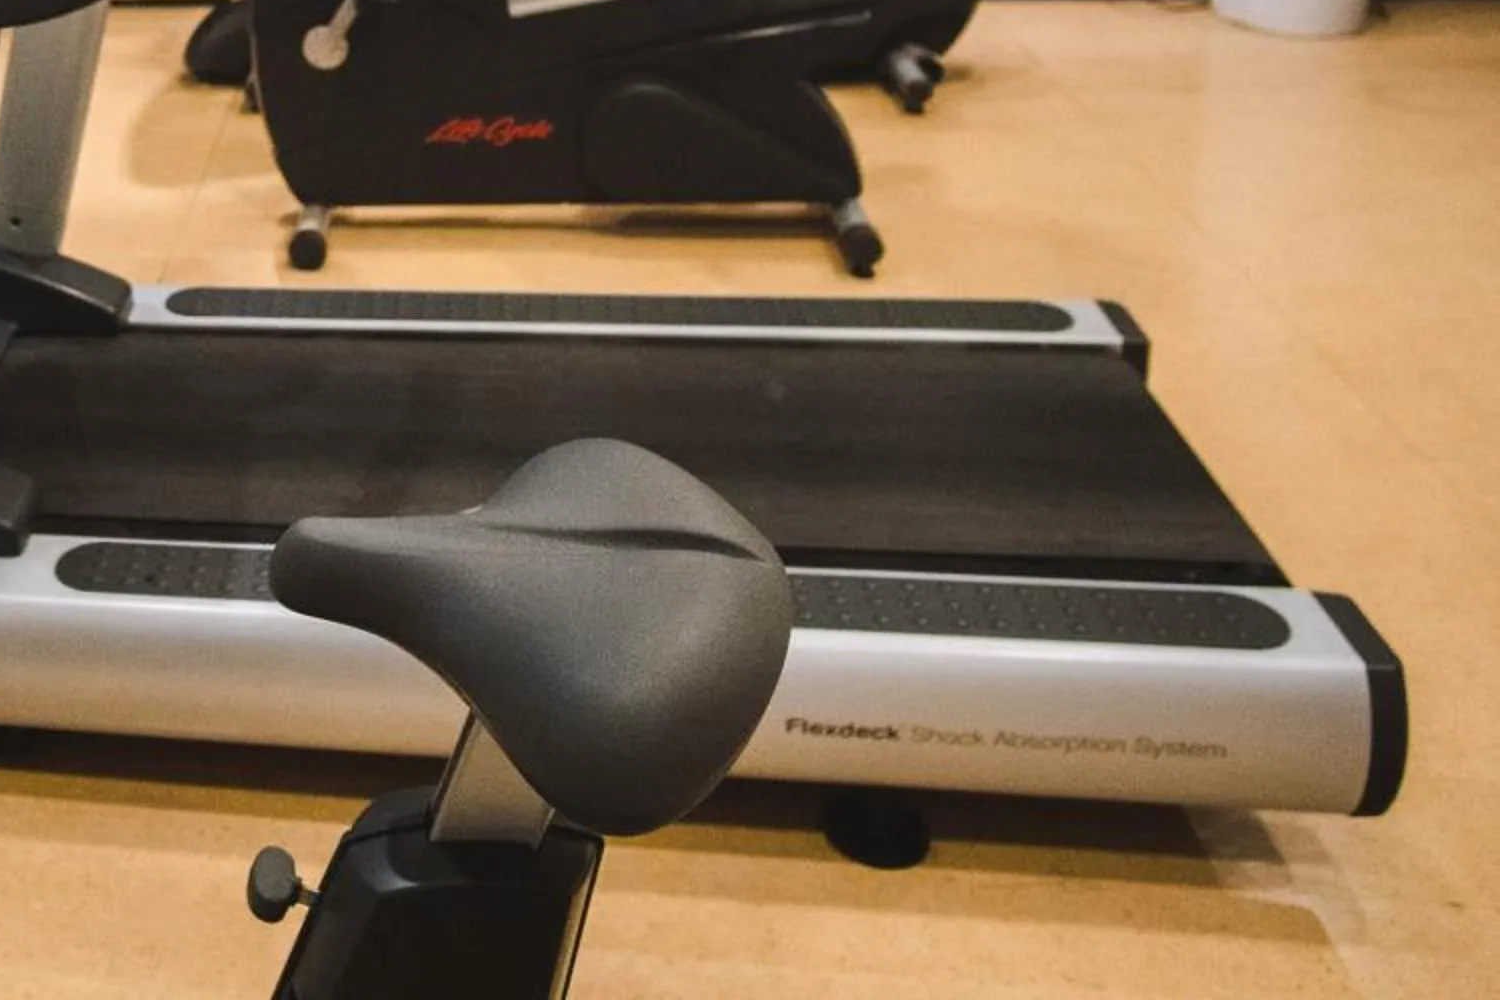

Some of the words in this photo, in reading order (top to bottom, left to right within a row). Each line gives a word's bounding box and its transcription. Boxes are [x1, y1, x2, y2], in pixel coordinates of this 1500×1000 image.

[784, 716, 901, 742] Flexdeck
[909, 724, 986, 747] Shock
[993, 729, 1129, 755] Absorption
[1133, 734, 1229, 760] System
